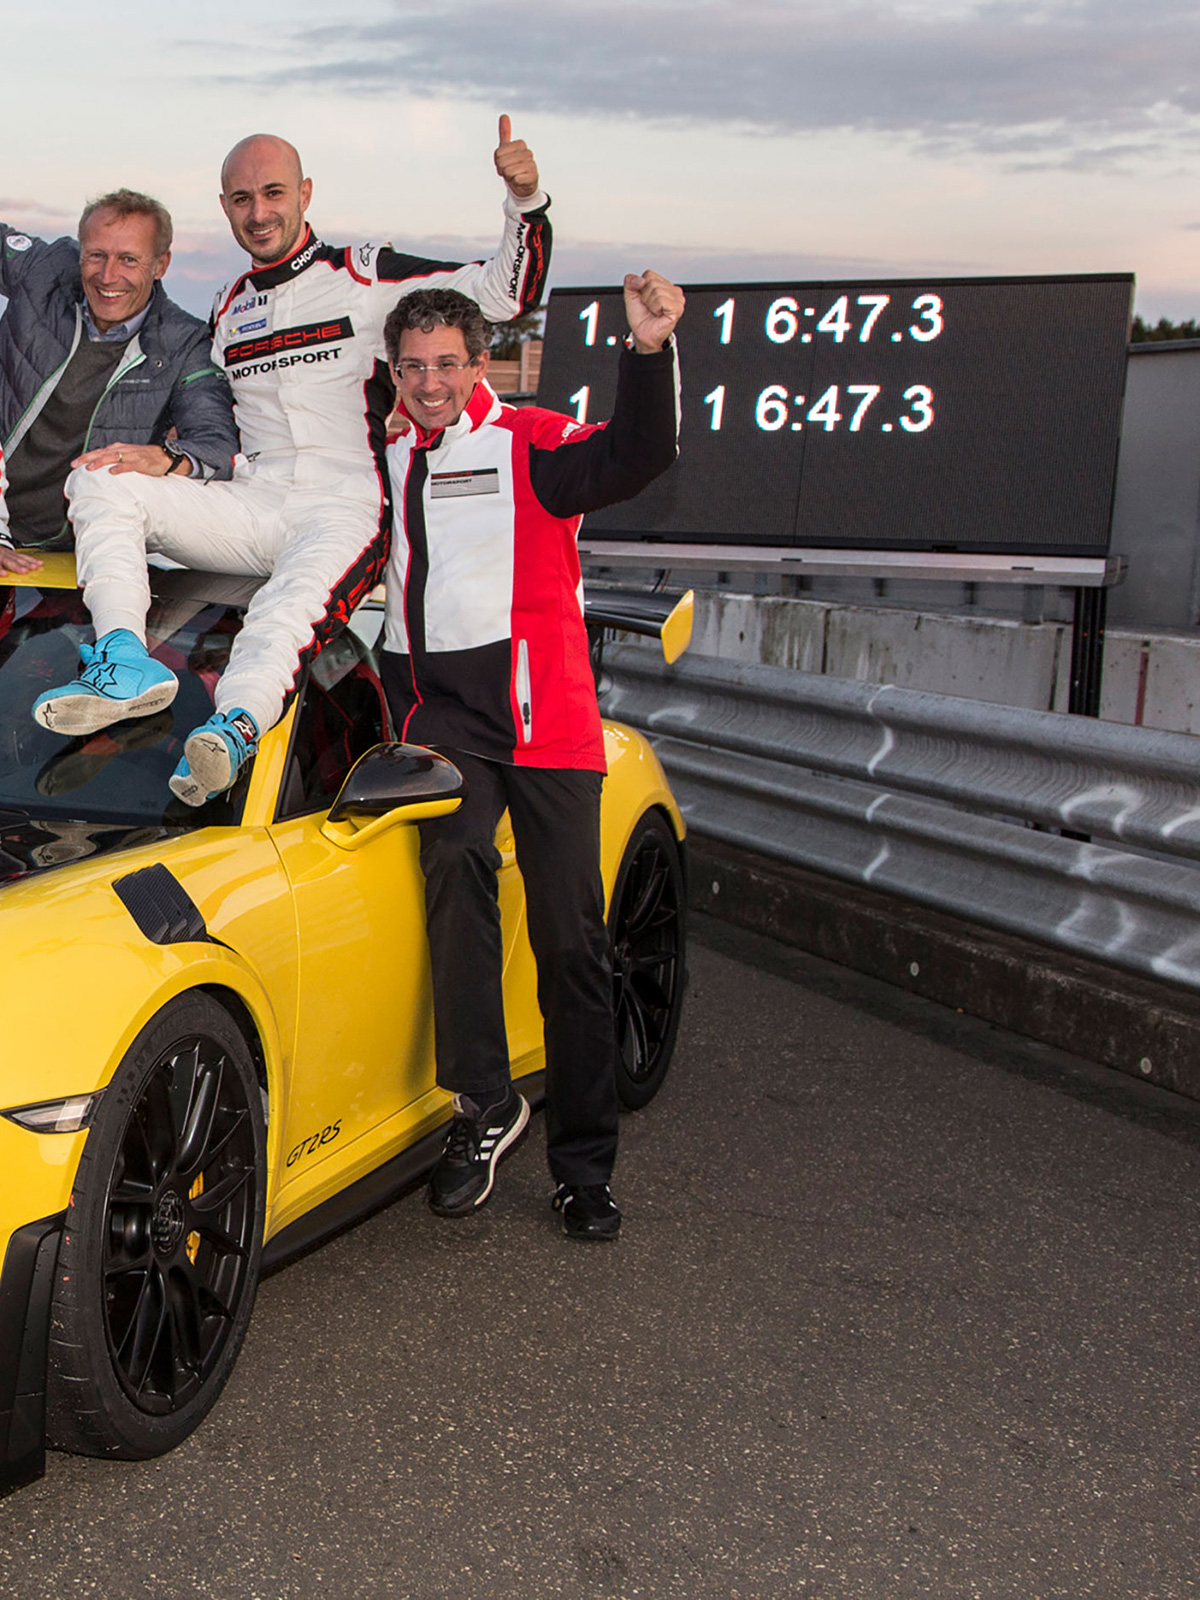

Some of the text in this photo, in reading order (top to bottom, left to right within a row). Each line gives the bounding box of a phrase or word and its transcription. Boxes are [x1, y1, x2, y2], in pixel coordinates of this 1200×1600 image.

[231, 297, 257, 316] Mobil
[713, 298, 736, 345] 1
[764, 293, 945, 344] 6:47.3
[227, 323, 343, 359] PORSCHE
[703, 385, 726, 431] 1
[754, 384, 935, 433] 6:47.3
